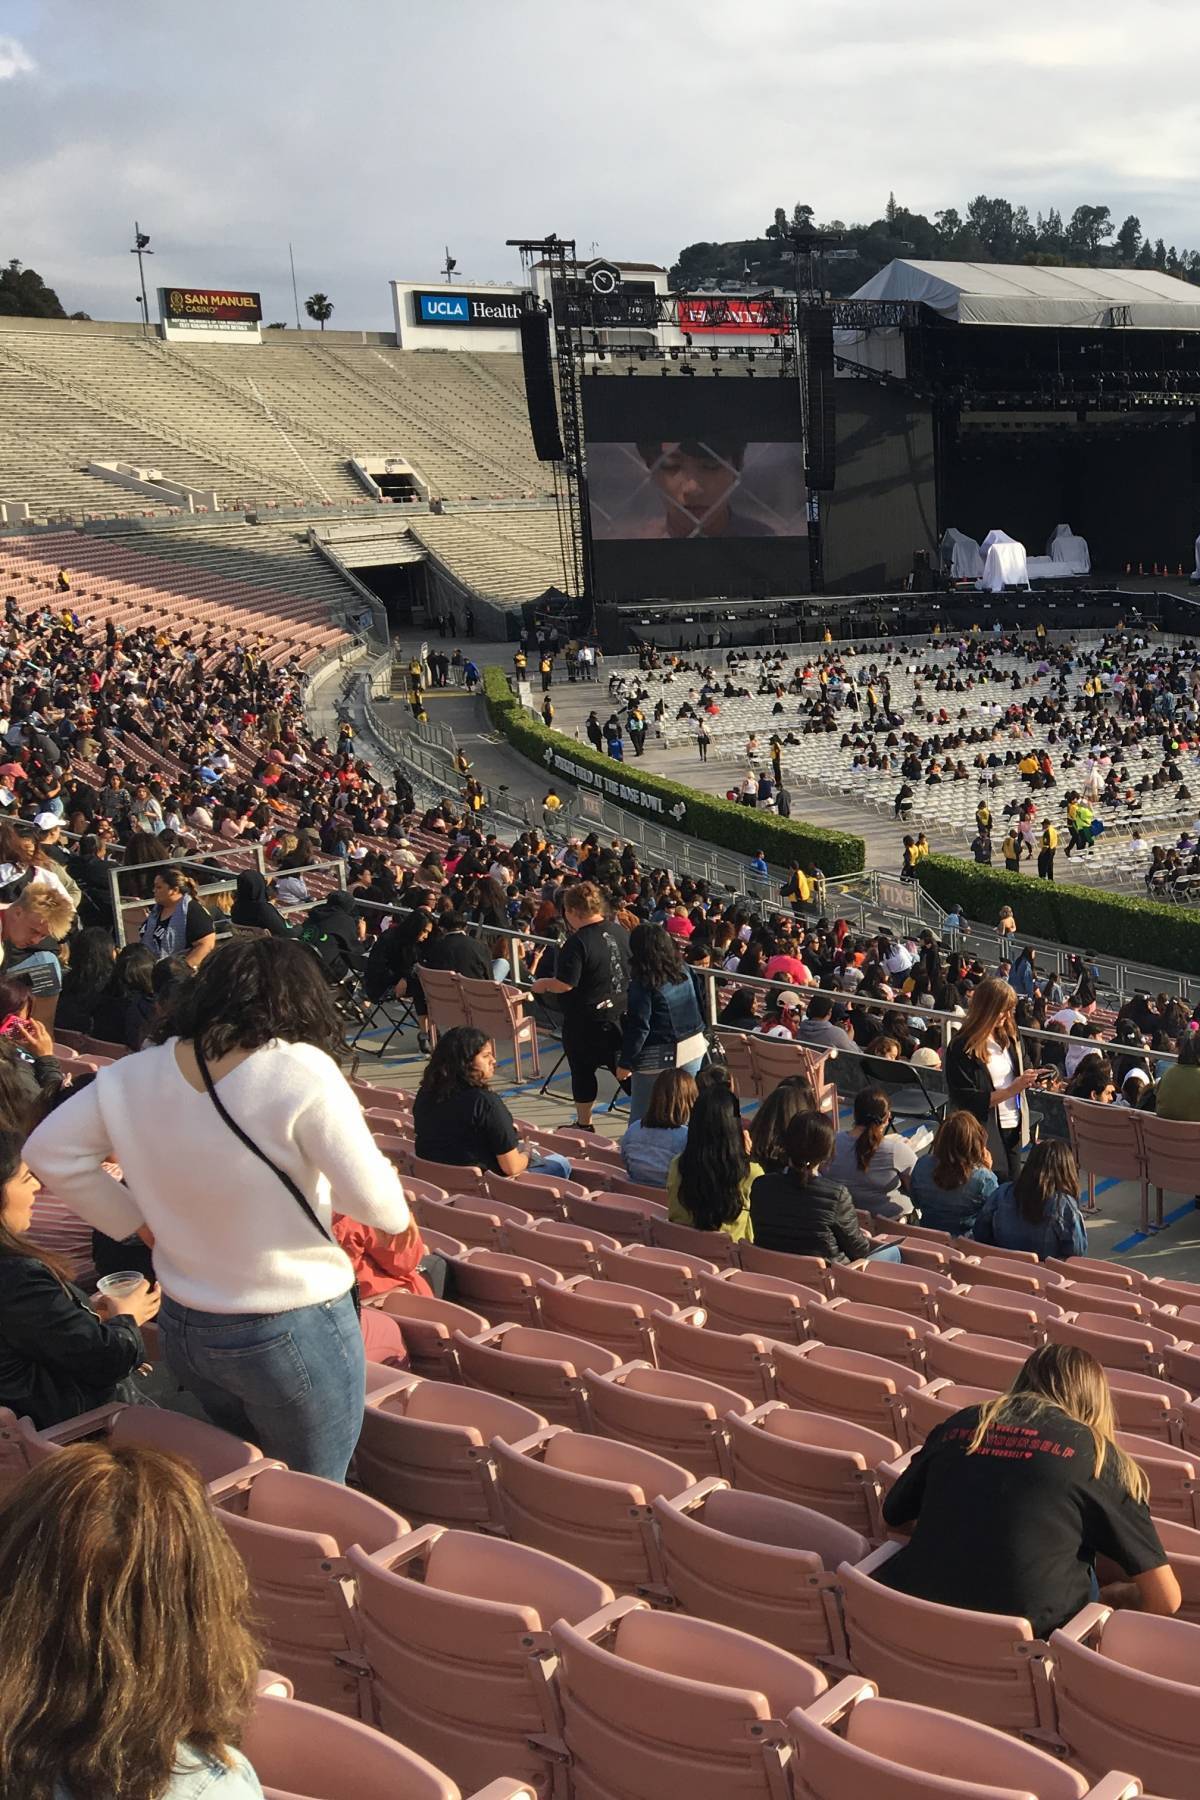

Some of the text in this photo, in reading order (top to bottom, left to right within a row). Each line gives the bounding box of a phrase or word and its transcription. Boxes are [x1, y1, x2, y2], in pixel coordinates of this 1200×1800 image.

[185, 294, 257, 308] SAN MANUEL
[428, 302, 522, 318] UCLA Health
[604, 777, 620, 796] THE
[620, 784, 640, 804] ROSE
[640, 792, 665, 814] BOWL
